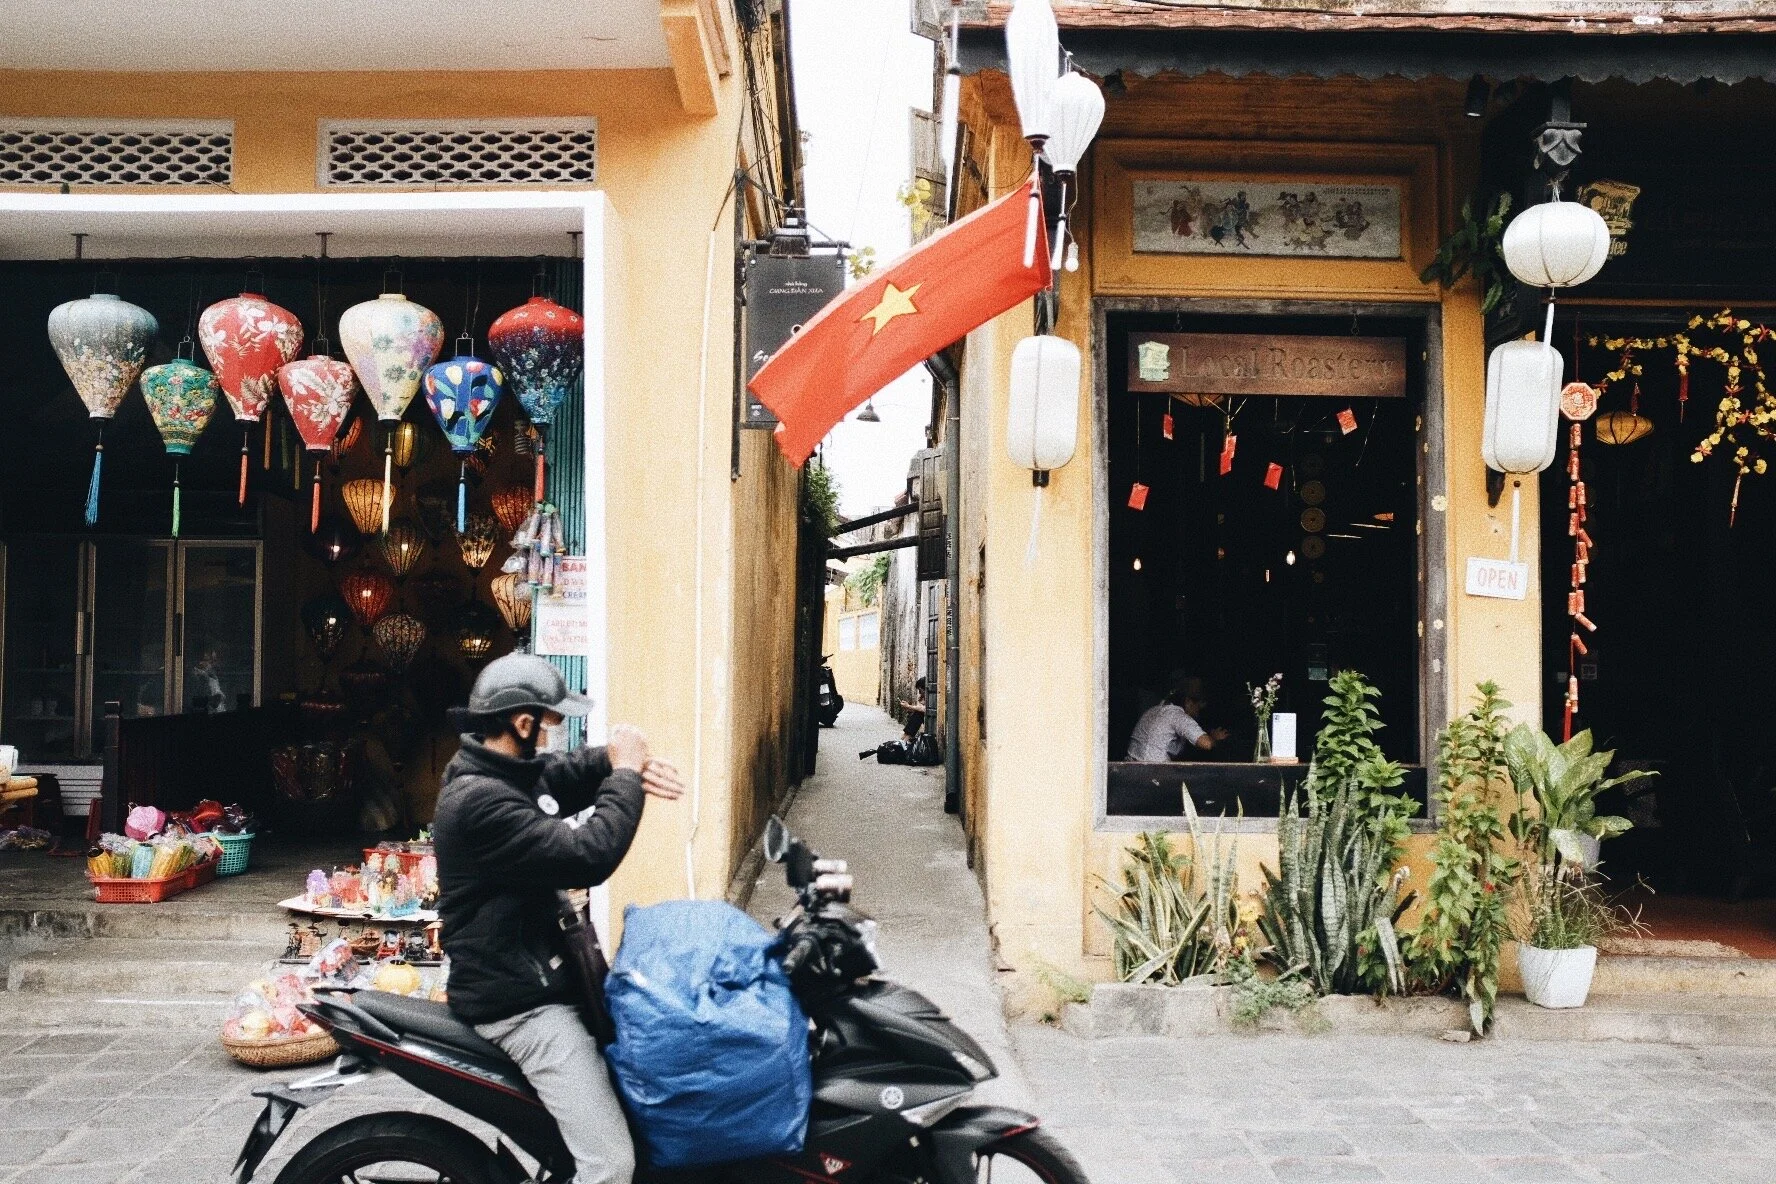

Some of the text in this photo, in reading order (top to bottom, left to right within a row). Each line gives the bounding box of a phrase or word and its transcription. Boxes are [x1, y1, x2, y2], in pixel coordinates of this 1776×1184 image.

[1179, 345, 1396, 391] Local Roastery
[1477, 567, 1518, 590] OPEN
